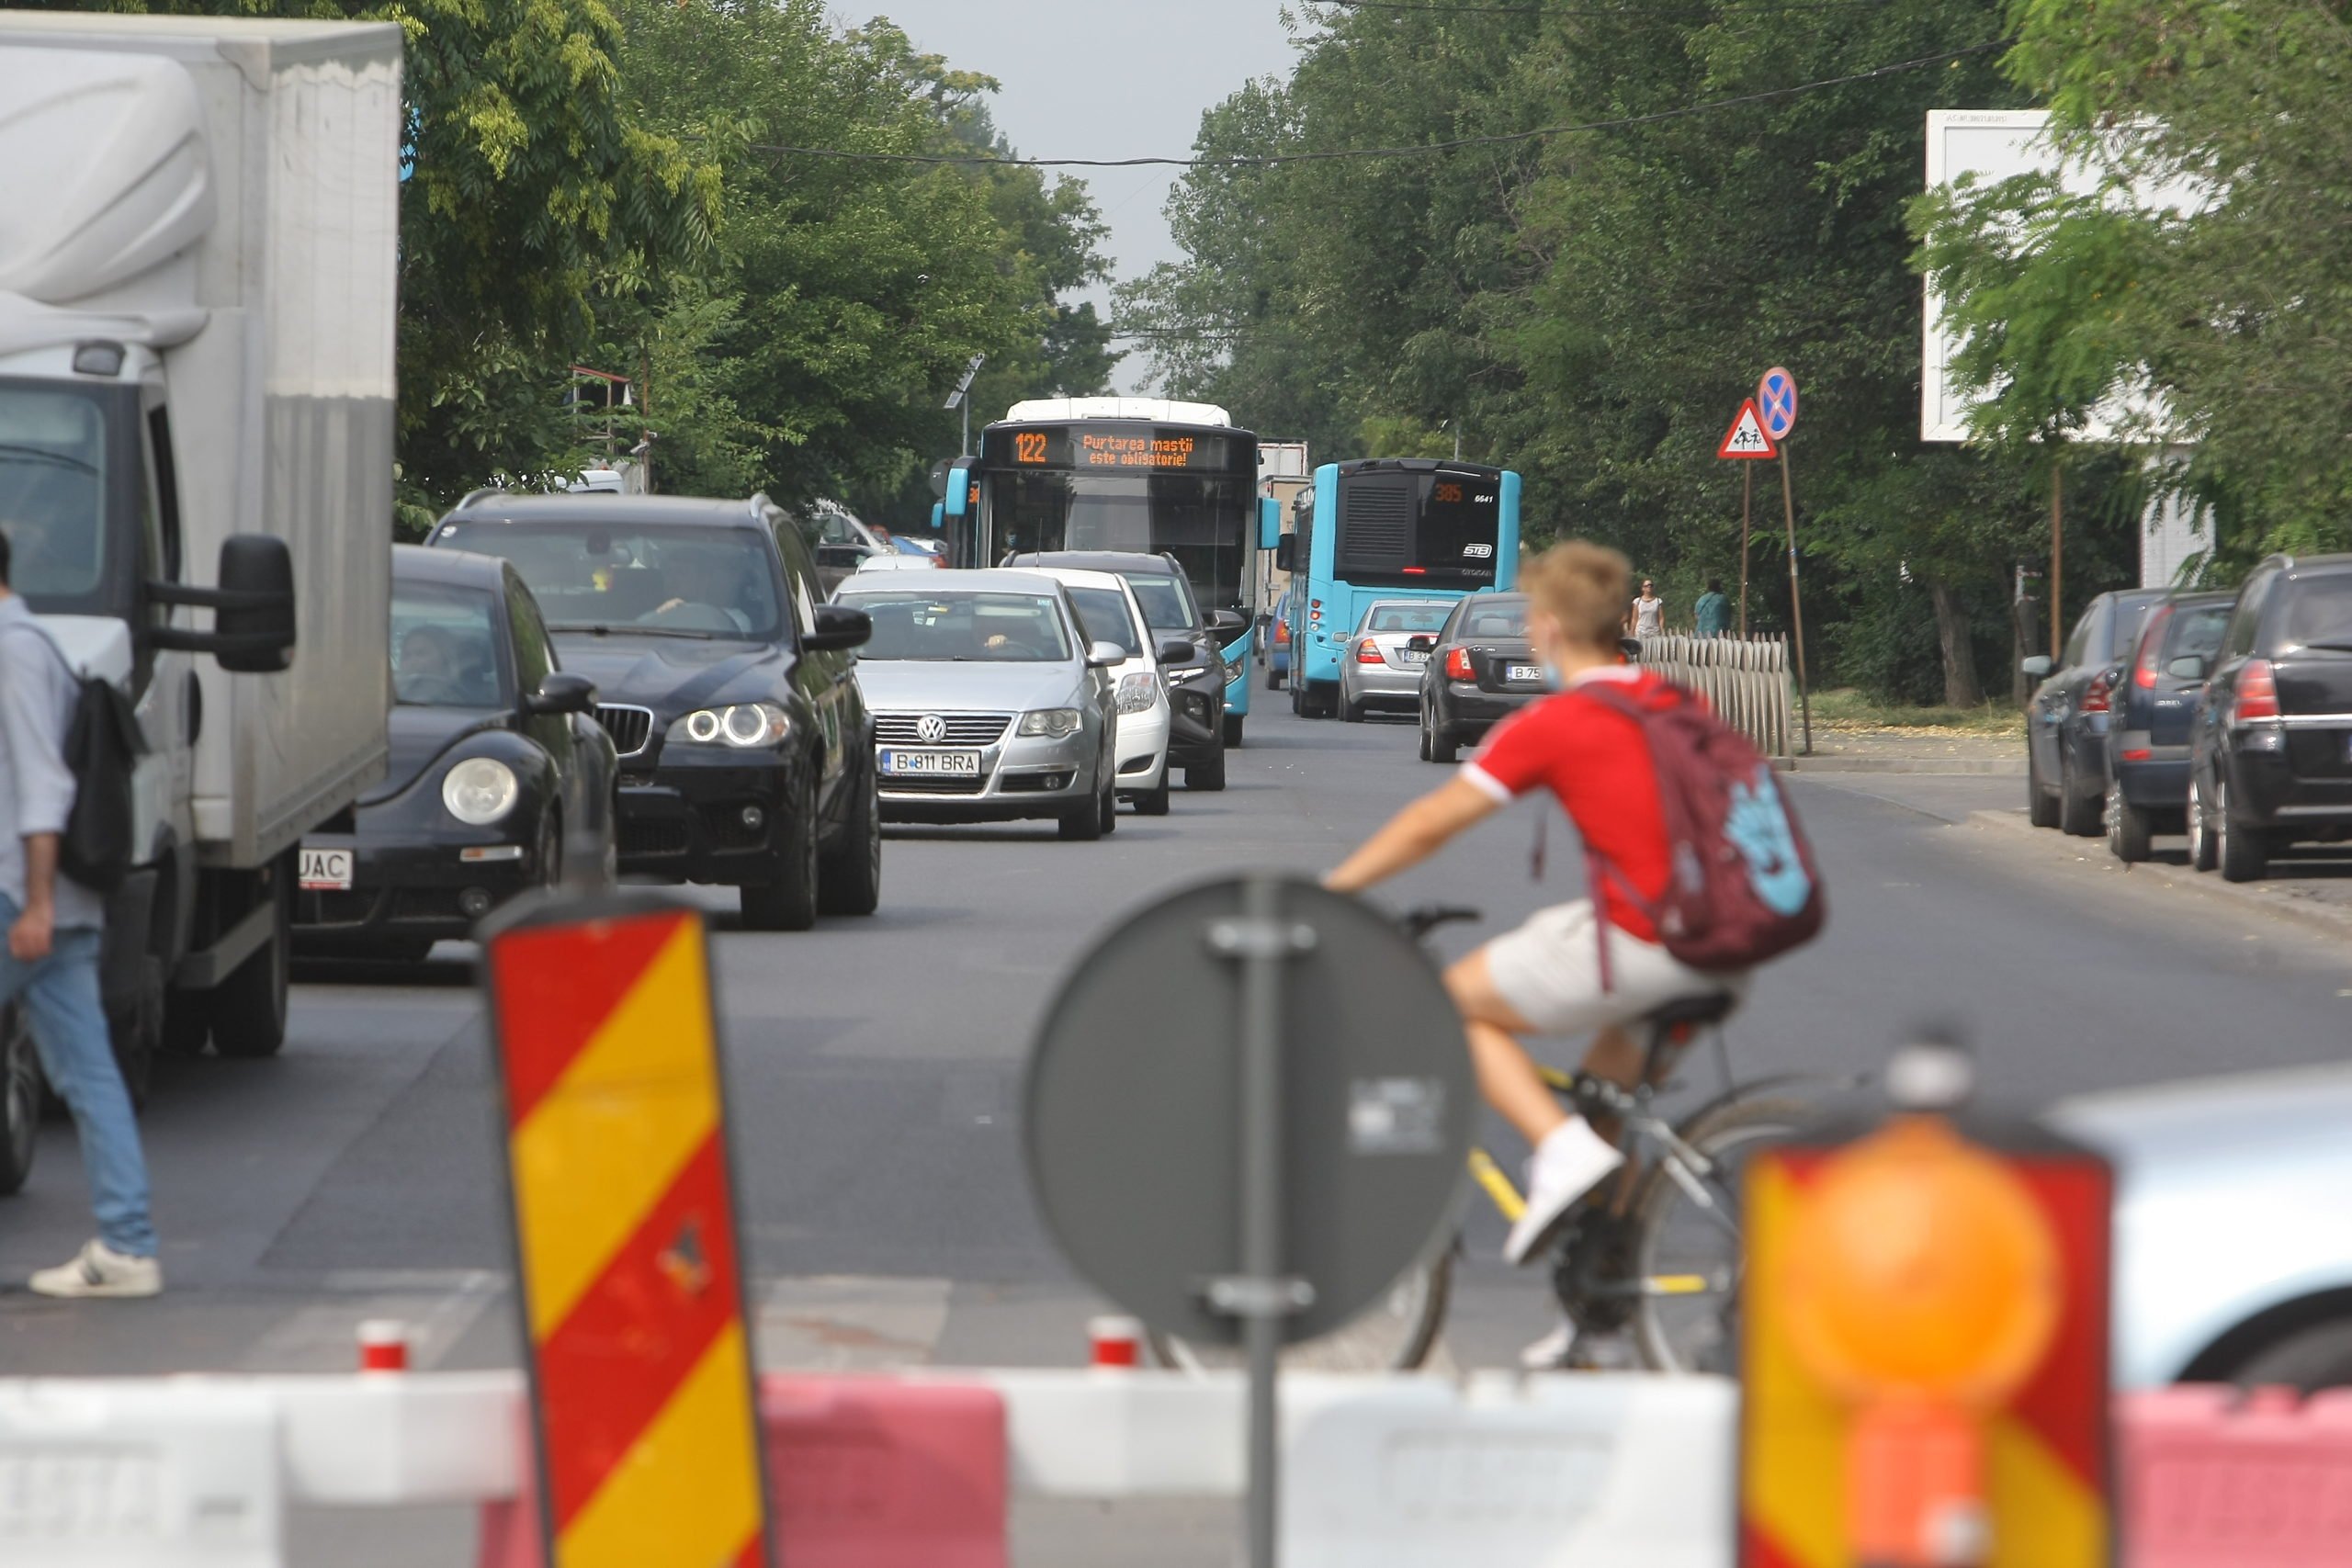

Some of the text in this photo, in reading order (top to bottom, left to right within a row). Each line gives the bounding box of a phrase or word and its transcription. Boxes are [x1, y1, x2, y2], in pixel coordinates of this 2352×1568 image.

[1015, 433, 1047, 463] 122
[1083, 434, 1193, 452] Purtarea mastii
[1089, 450, 1116, 465] este
[1435, 483, 1462, 502] 385
[1463, 545, 1490, 556] STB
[1516, 667, 1541, 678] B 75
[897, 754, 975, 771] B 811 BRA
